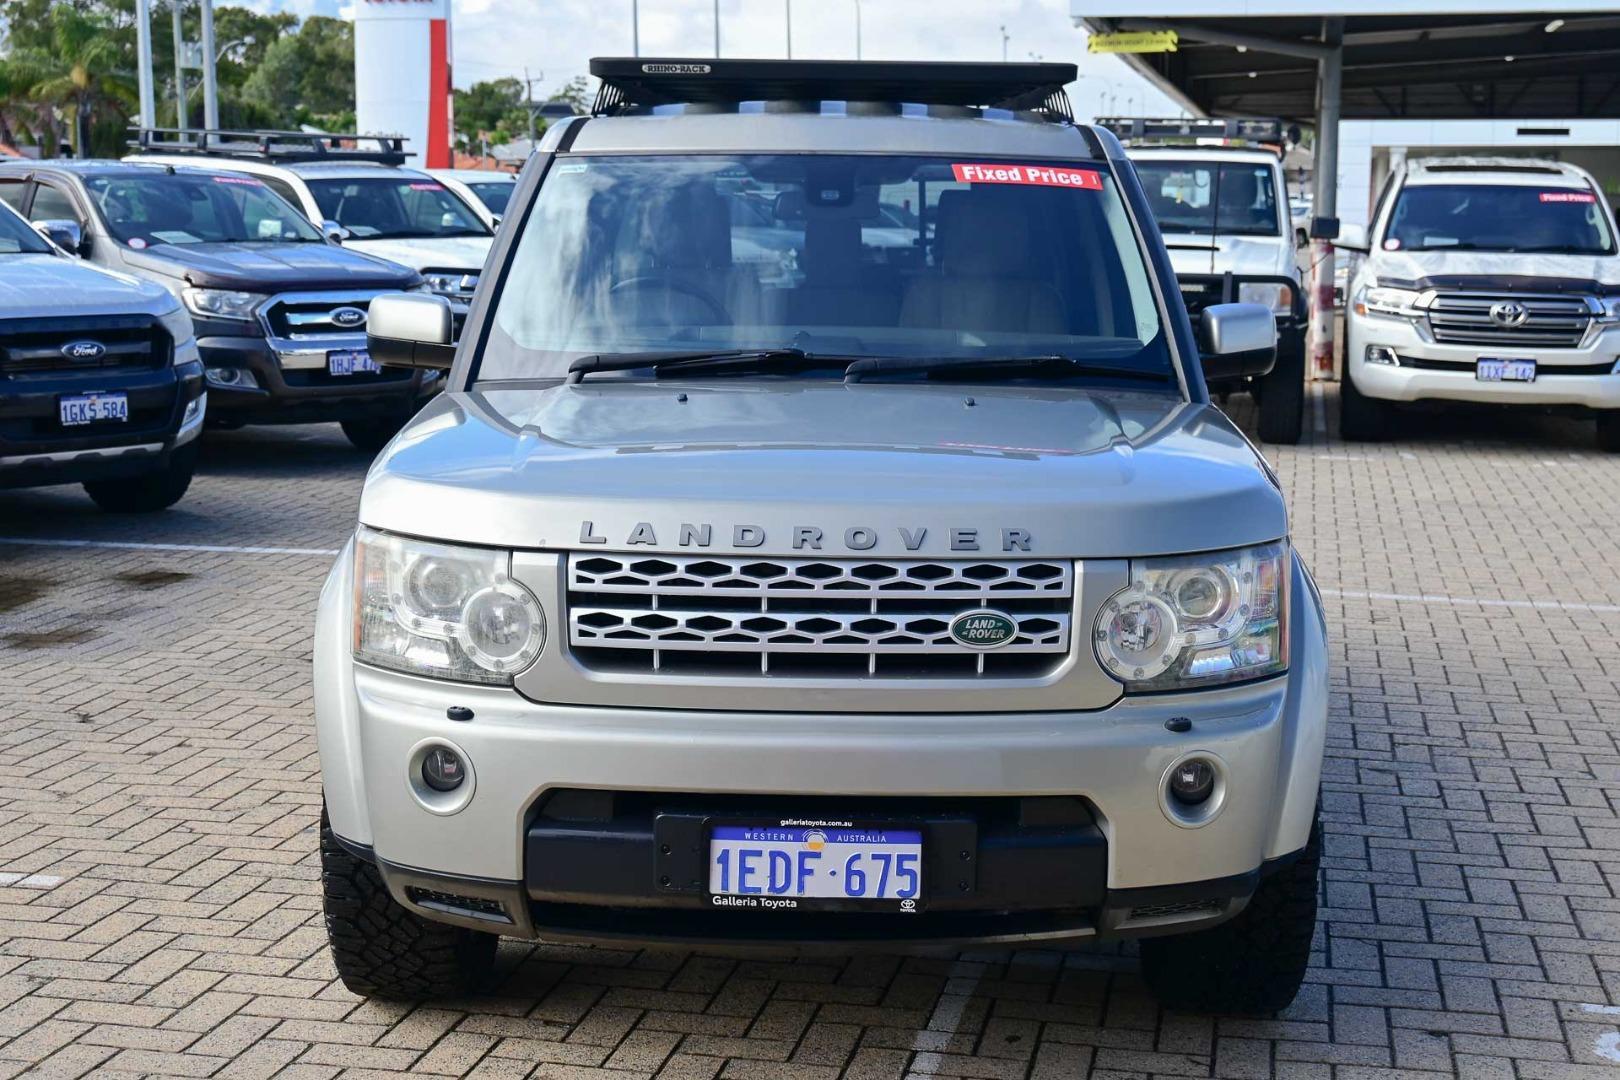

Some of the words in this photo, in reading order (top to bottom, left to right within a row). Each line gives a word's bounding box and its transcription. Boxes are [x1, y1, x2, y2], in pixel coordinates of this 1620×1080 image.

[961, 166, 1022, 181] Fixed
[1025, 168, 1084, 185] Price
[73, 344, 98, 356] Ford
[579, 520, 766, 547] LAND
[792, 526, 1032, 551] ROVER
[965, 619, 996, 629] LAND
[967, 629, 1005, 638] ROVER
[780, 818, 853, 827] galleriatoyota.com.au
[744, 832, 794, 841] WESTERN
[836, 834, 887, 843] AUSTRALIA
[712, 895, 757, 907] Galleria
[761, 898, 797, 909] Toyota
